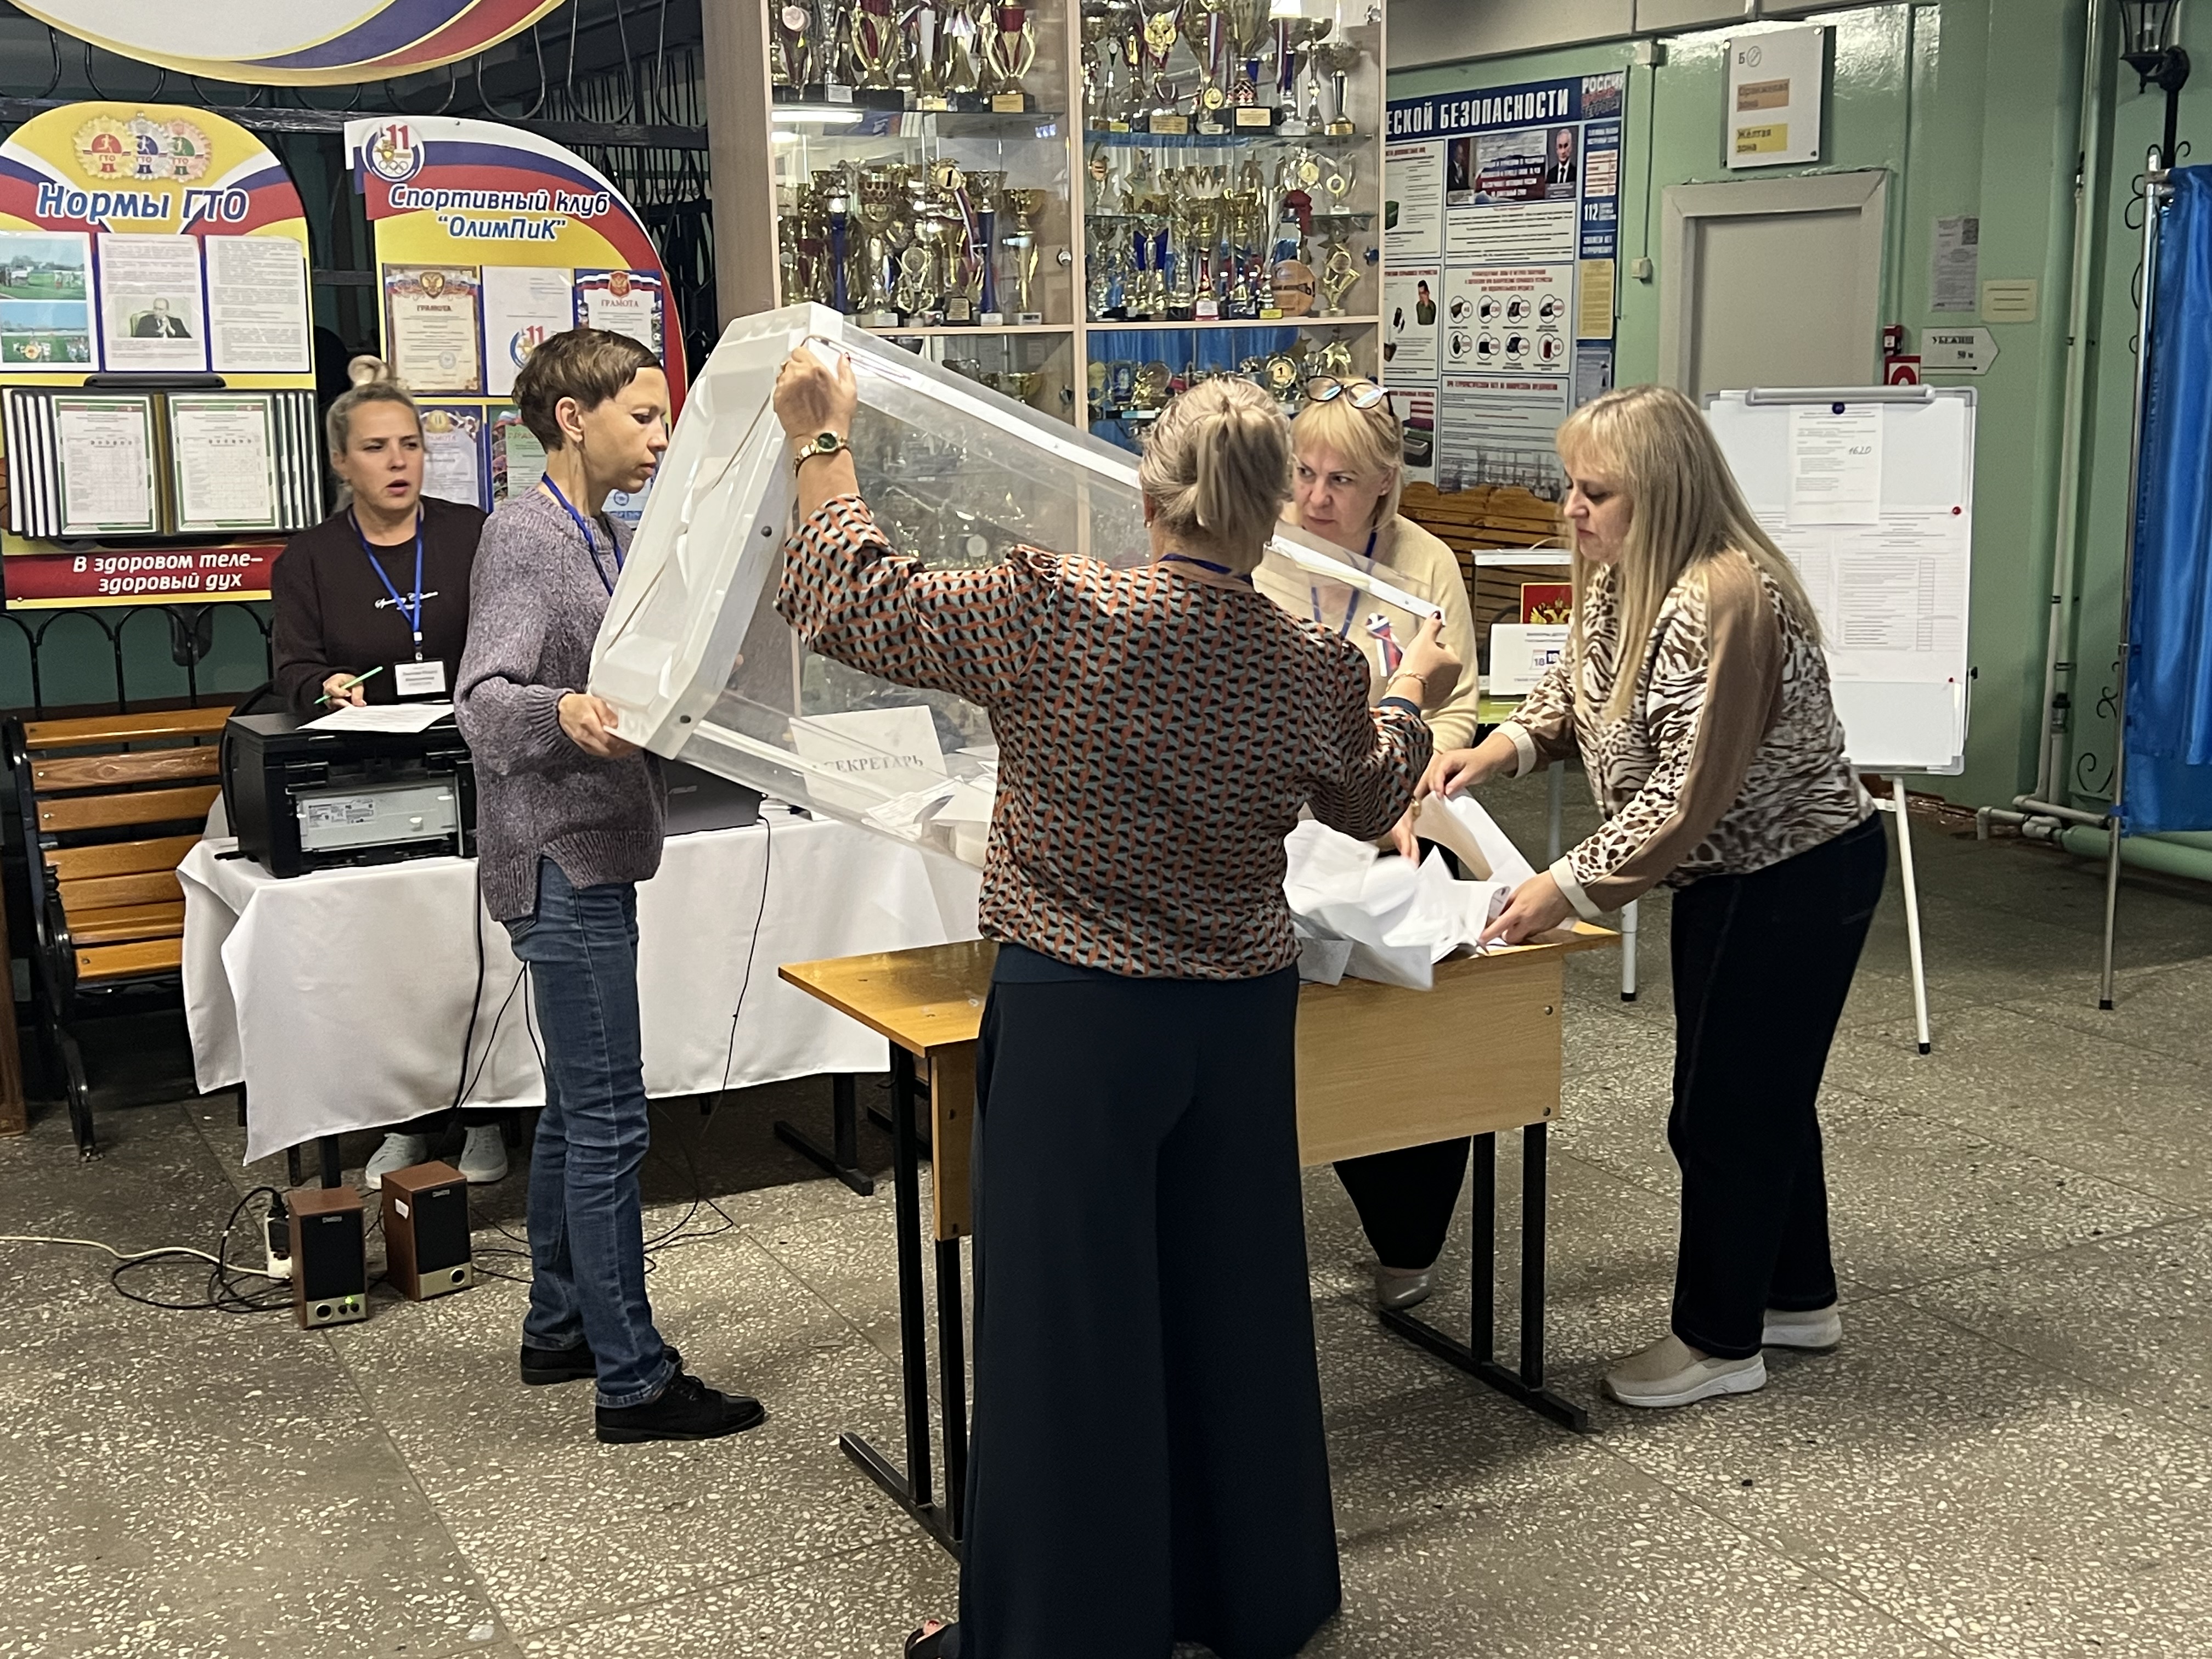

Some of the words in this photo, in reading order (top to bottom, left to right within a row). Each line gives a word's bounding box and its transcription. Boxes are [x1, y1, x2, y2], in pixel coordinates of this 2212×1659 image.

[1440, 89, 1569, 129] БЕЗОПАСНОСТИ
[386, 124, 409, 150] 11
[38, 185, 169, 222] Нормы
[182, 190, 248, 219] ГТО
[390, 185, 548, 211] Спортивный
[556, 191, 611, 216] клуб
[1584, 203, 1599, 221] 112
[74, 556, 87, 572] В
[94, 555, 193, 573] здоровом
[99, 571, 200, 592] здоровый
[205, 573, 242, 591] дух
